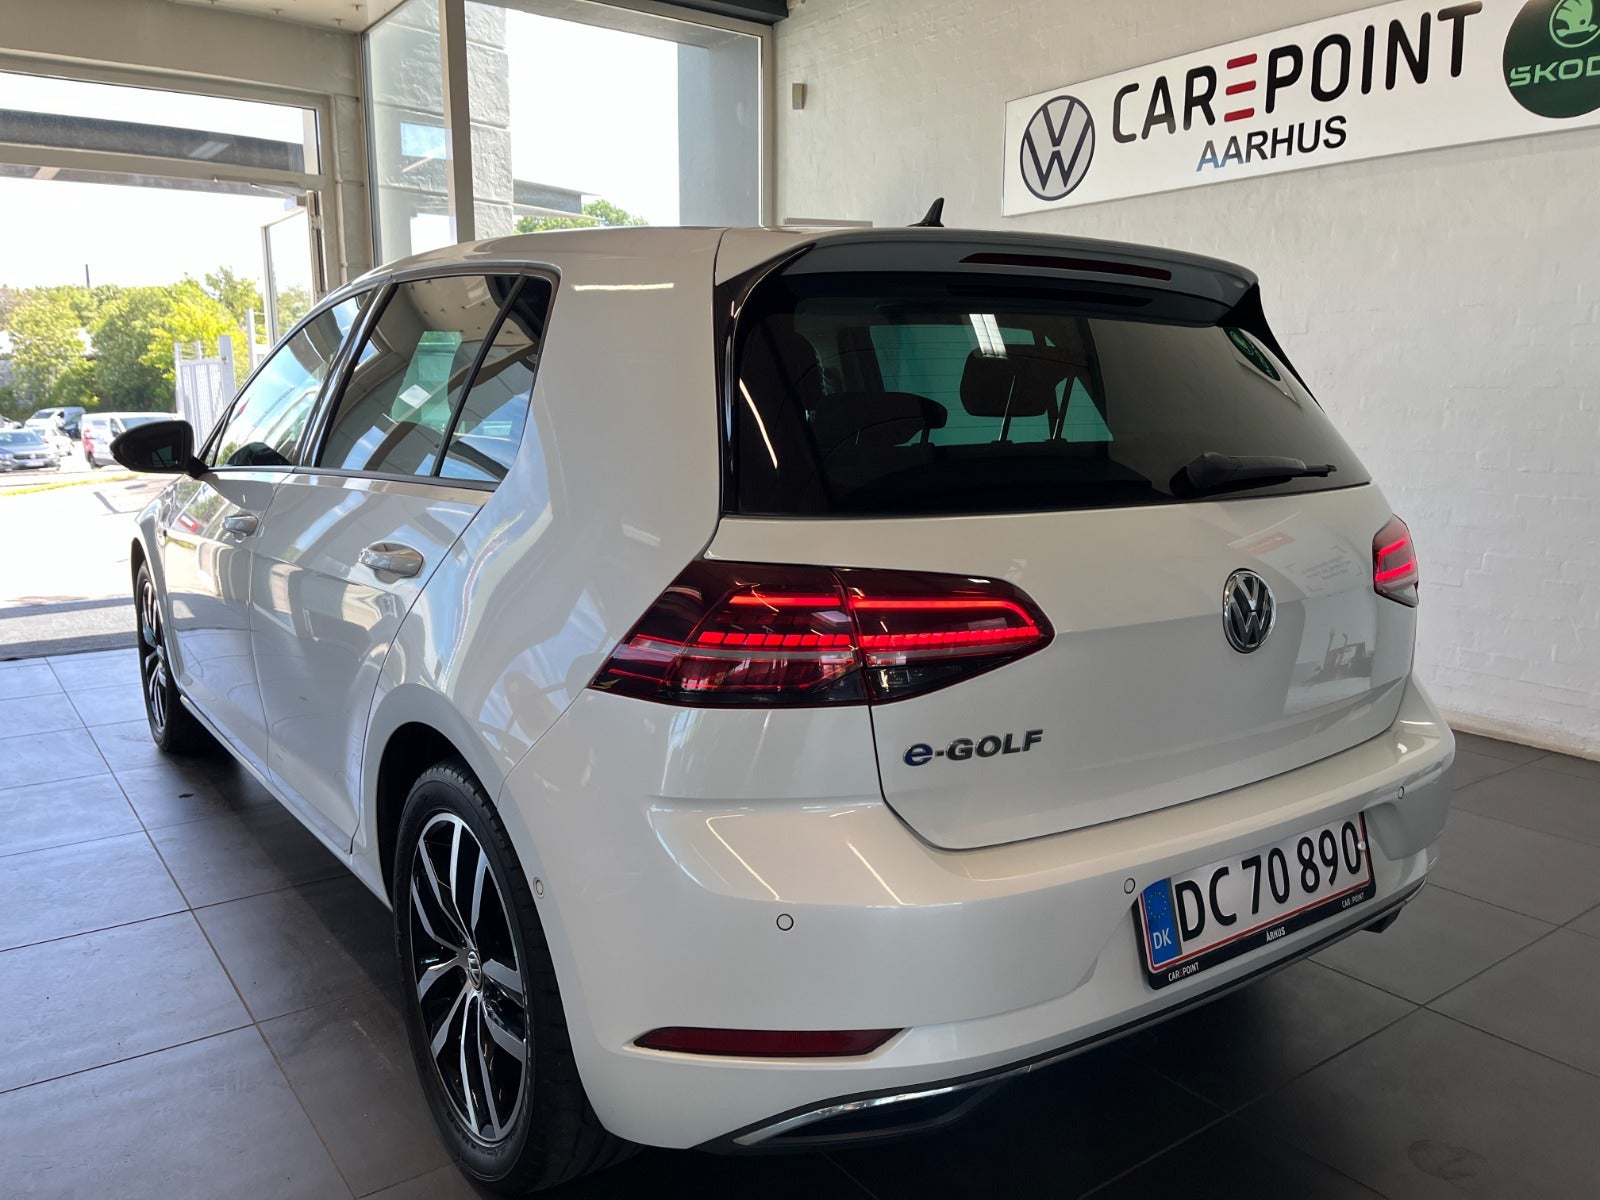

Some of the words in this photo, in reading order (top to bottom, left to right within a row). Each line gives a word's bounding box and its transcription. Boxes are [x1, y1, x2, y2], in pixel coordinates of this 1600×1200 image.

[1196, 115, 1347, 172] AARHUS
[903, 729, 1043, 766] e-GOLF
[1174, 866, 1237, 942] DC
[1241, 847, 1290, 914] 70
[1297, 820, 1362, 893] 890
[1153, 928, 1172, 950] DK
